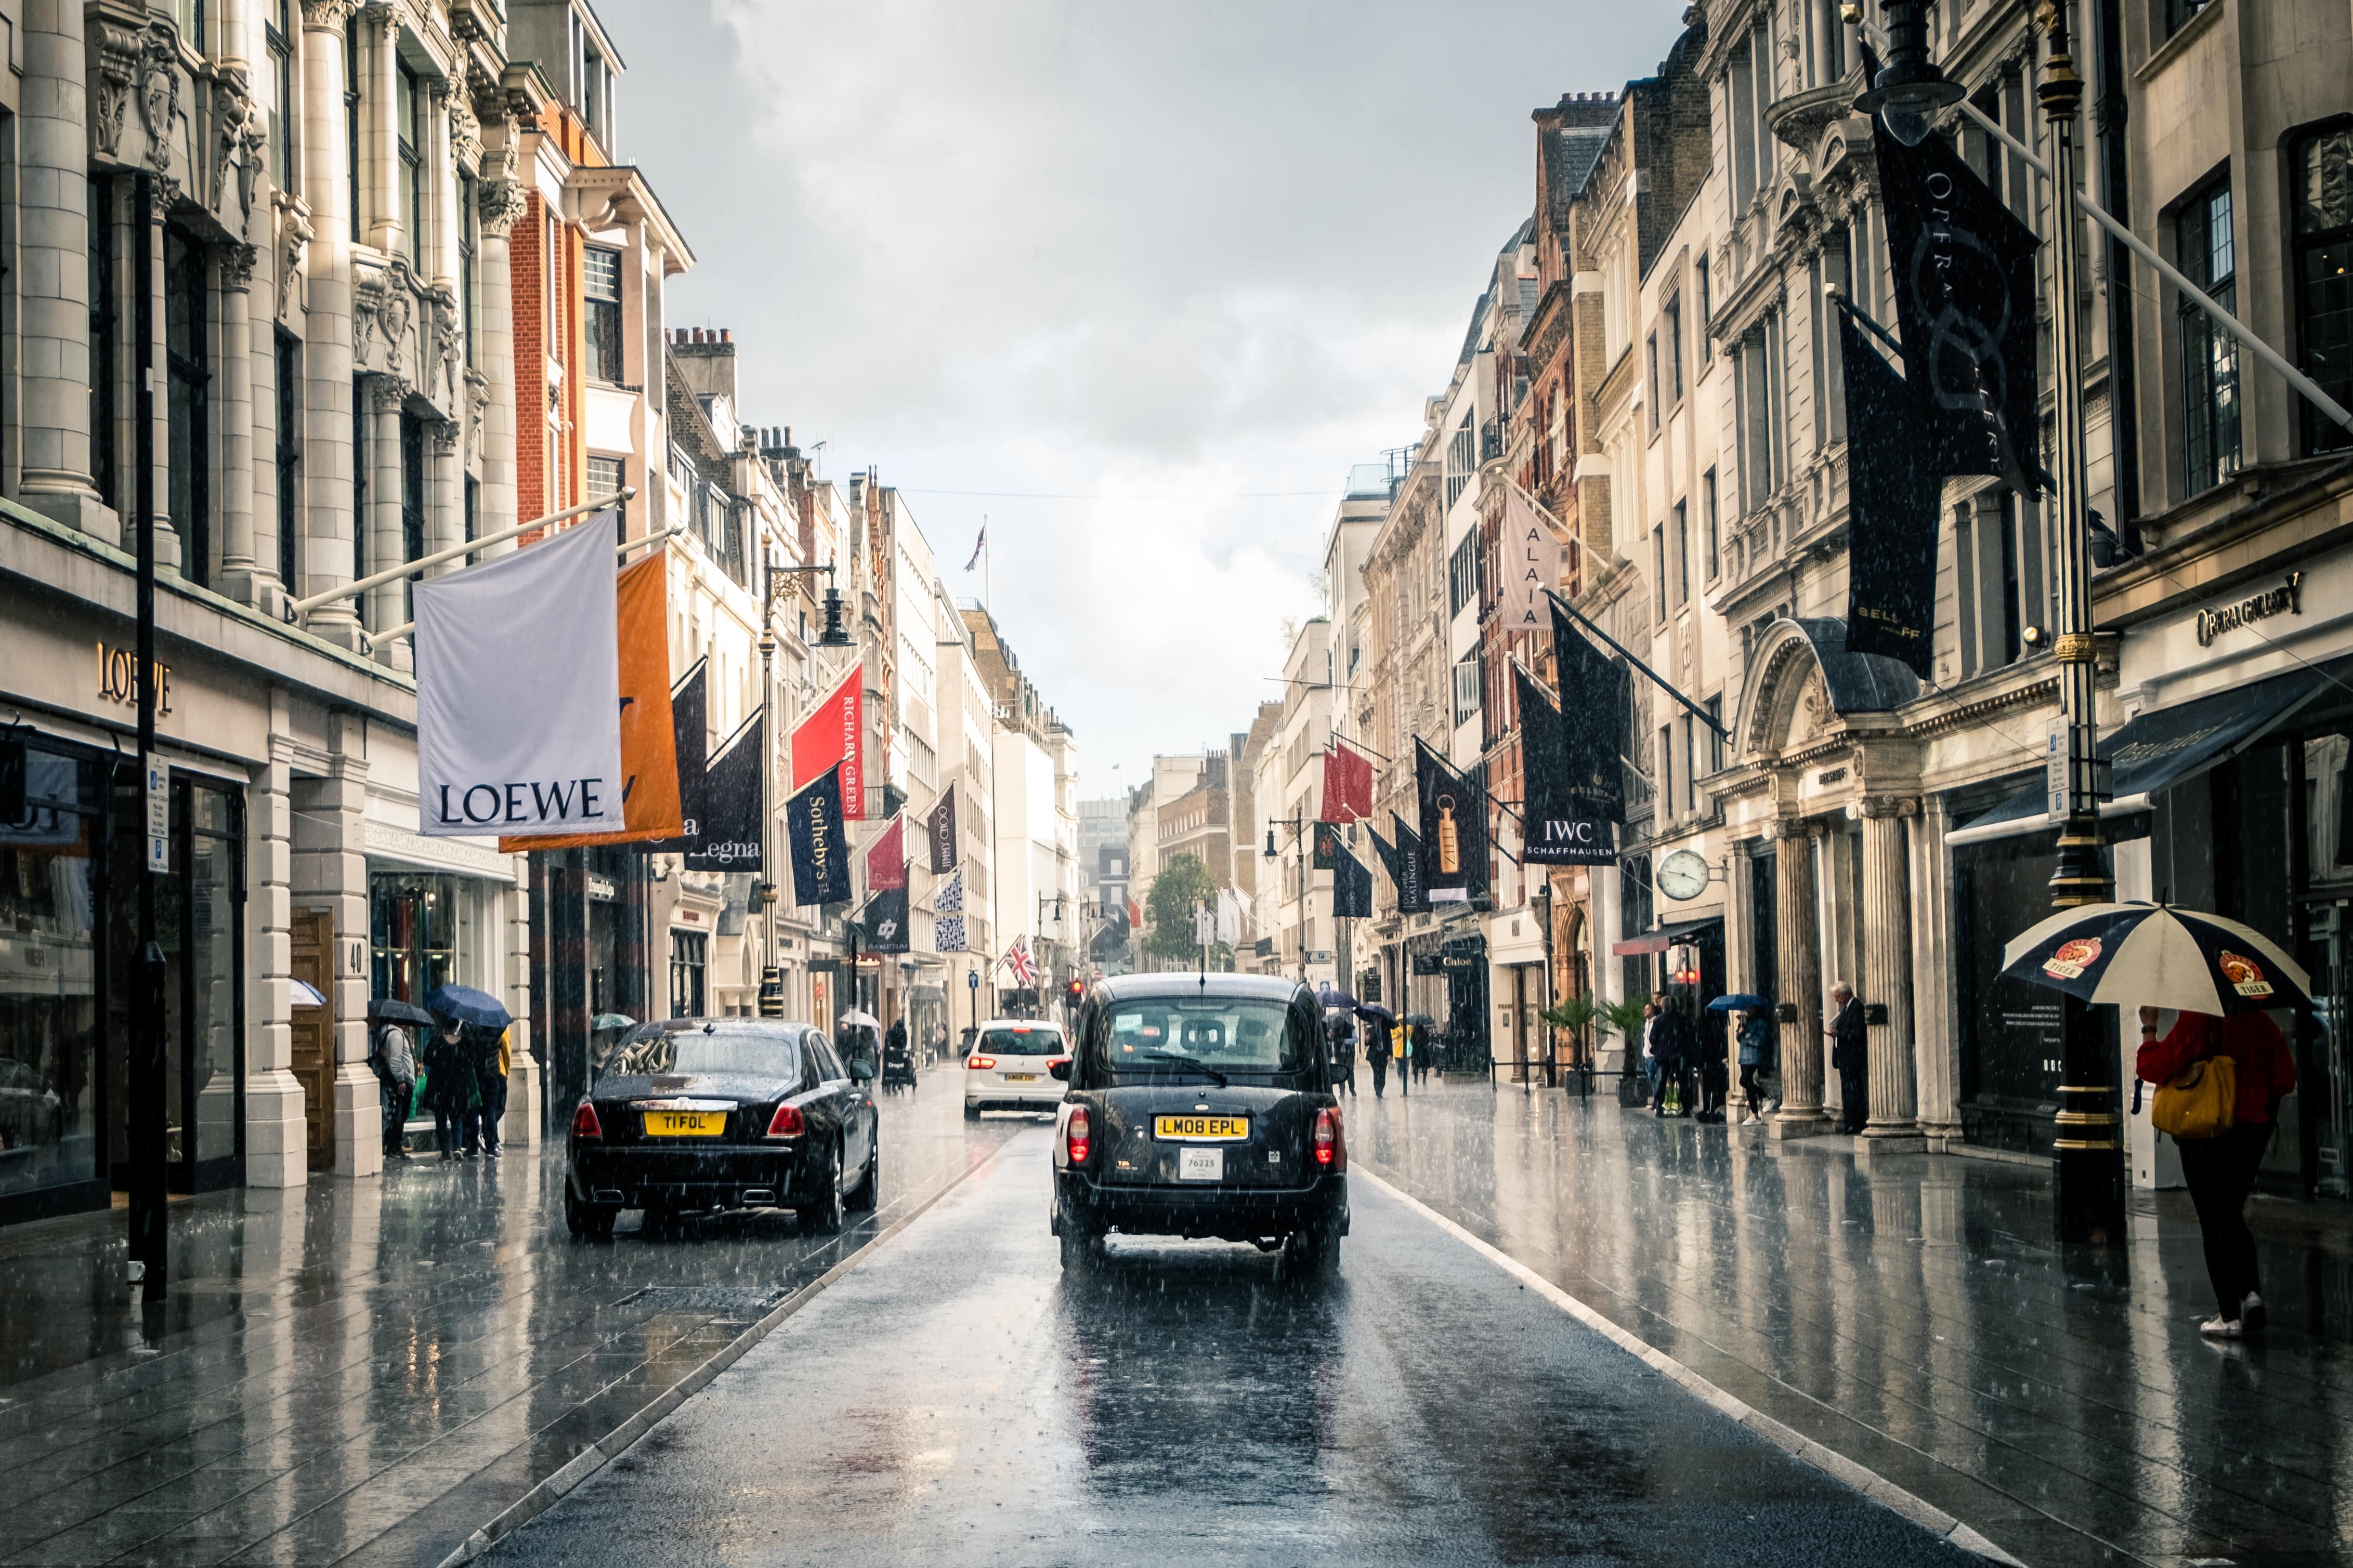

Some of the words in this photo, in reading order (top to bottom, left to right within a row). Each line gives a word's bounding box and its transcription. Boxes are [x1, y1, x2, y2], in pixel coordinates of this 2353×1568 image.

[1858, 607, 1920, 639] BELSFF
[440, 778, 604, 823] LOEWE
[846, 766, 857, 813] GREEN
[809, 796, 829, 880] Sotheby's
[1545, 821, 1592, 842] IWC
[689, 840, 761, 863] egna
[942, 842, 951, 869] JIMMY
[1443, 827, 1455, 865] ZILLI
[1527, 847, 1612, 856] SCHAFFHAUSEN
[1408, 851, 1417, 904] MALINGUE
[350, 943, 361, 973] 40
[2050, 963, 2075, 976] TIGER
[2241, 985, 2267, 994] TIGER
[679, 1116, 705, 1128] FOL
[1163, 1119, 1205, 1133] LM08
[1210, 1120, 1240, 1134] EPL
